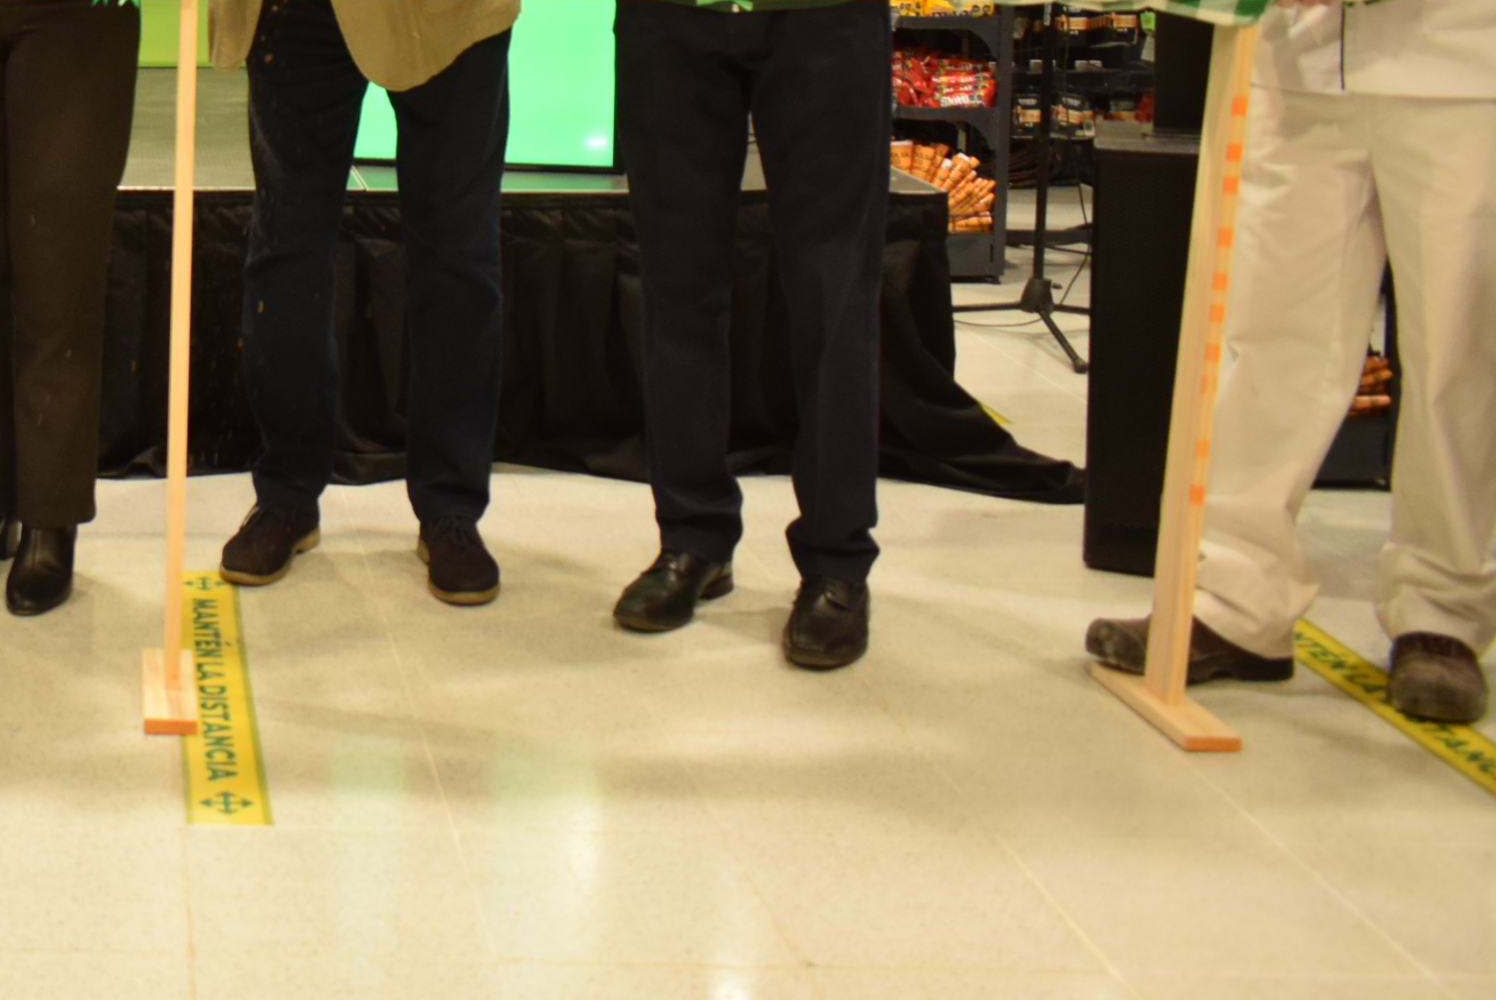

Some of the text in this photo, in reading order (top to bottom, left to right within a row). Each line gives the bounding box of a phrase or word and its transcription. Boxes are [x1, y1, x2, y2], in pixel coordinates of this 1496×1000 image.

[192, 597, 239, 781] MANTÉN LA DISTANCIA
